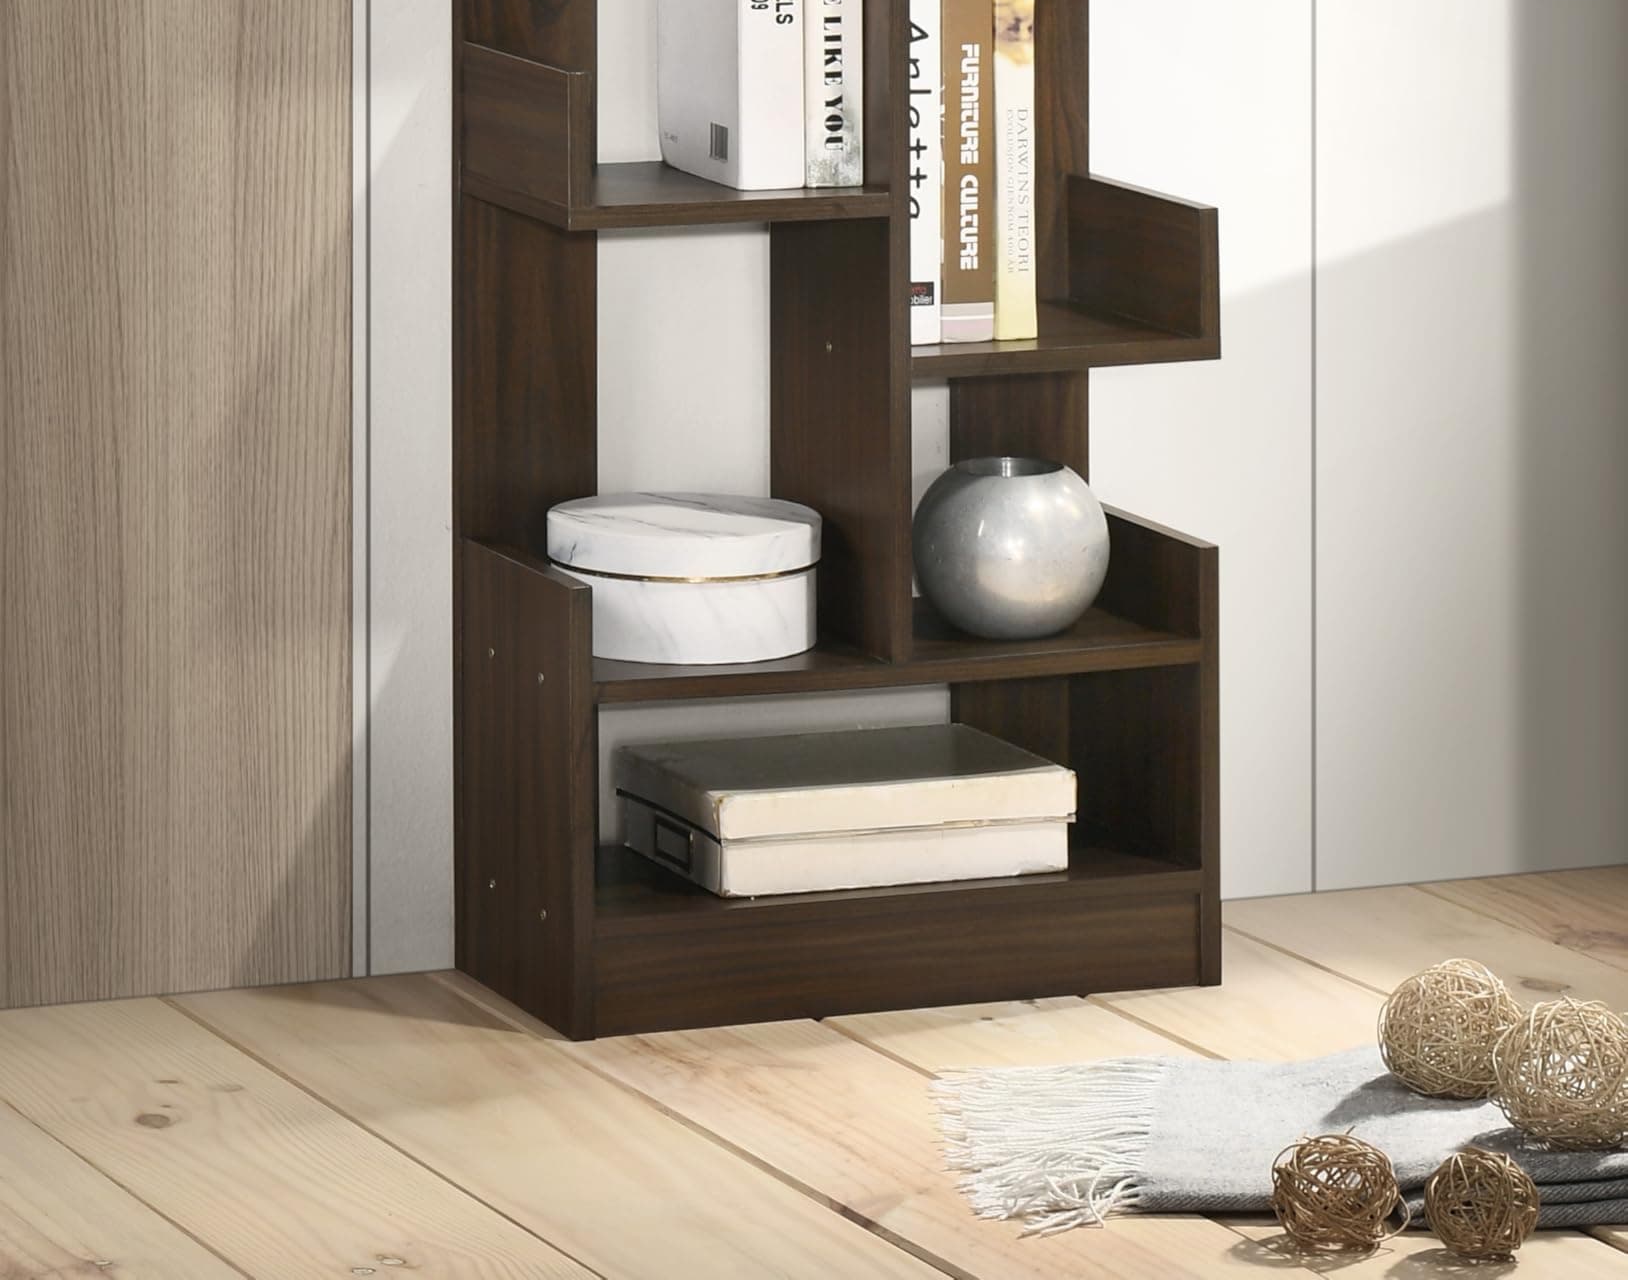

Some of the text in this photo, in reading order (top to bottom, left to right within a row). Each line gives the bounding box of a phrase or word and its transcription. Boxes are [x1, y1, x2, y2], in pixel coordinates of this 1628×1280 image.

[823, 15, 843, 86] LIKE
[824, 94, 844, 152] YOU
[959, 174, 979, 271] CULTURE
[1017, 108, 1029, 272] DARWINS TEORI
